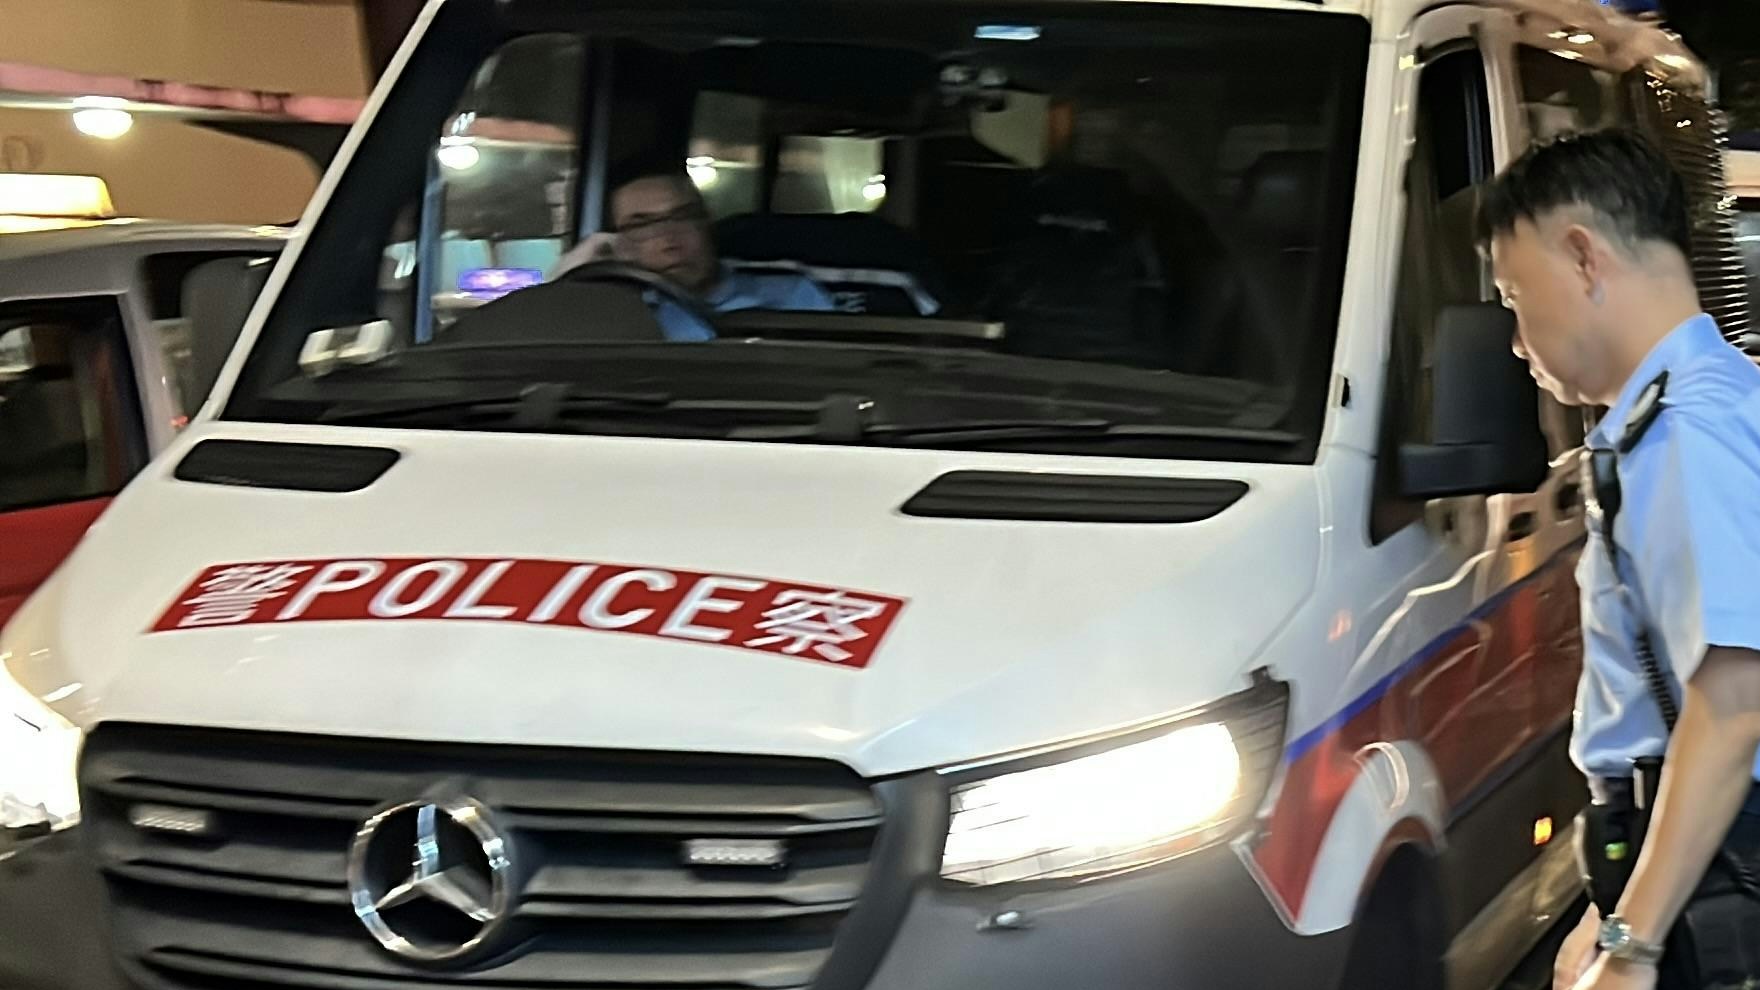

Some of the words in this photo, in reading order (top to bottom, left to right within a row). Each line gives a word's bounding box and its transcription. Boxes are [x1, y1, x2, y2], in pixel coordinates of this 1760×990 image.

[176, 562, 312, 628] 警
[275, 559, 764, 640] POLICE
[743, 587, 884, 662] 察
